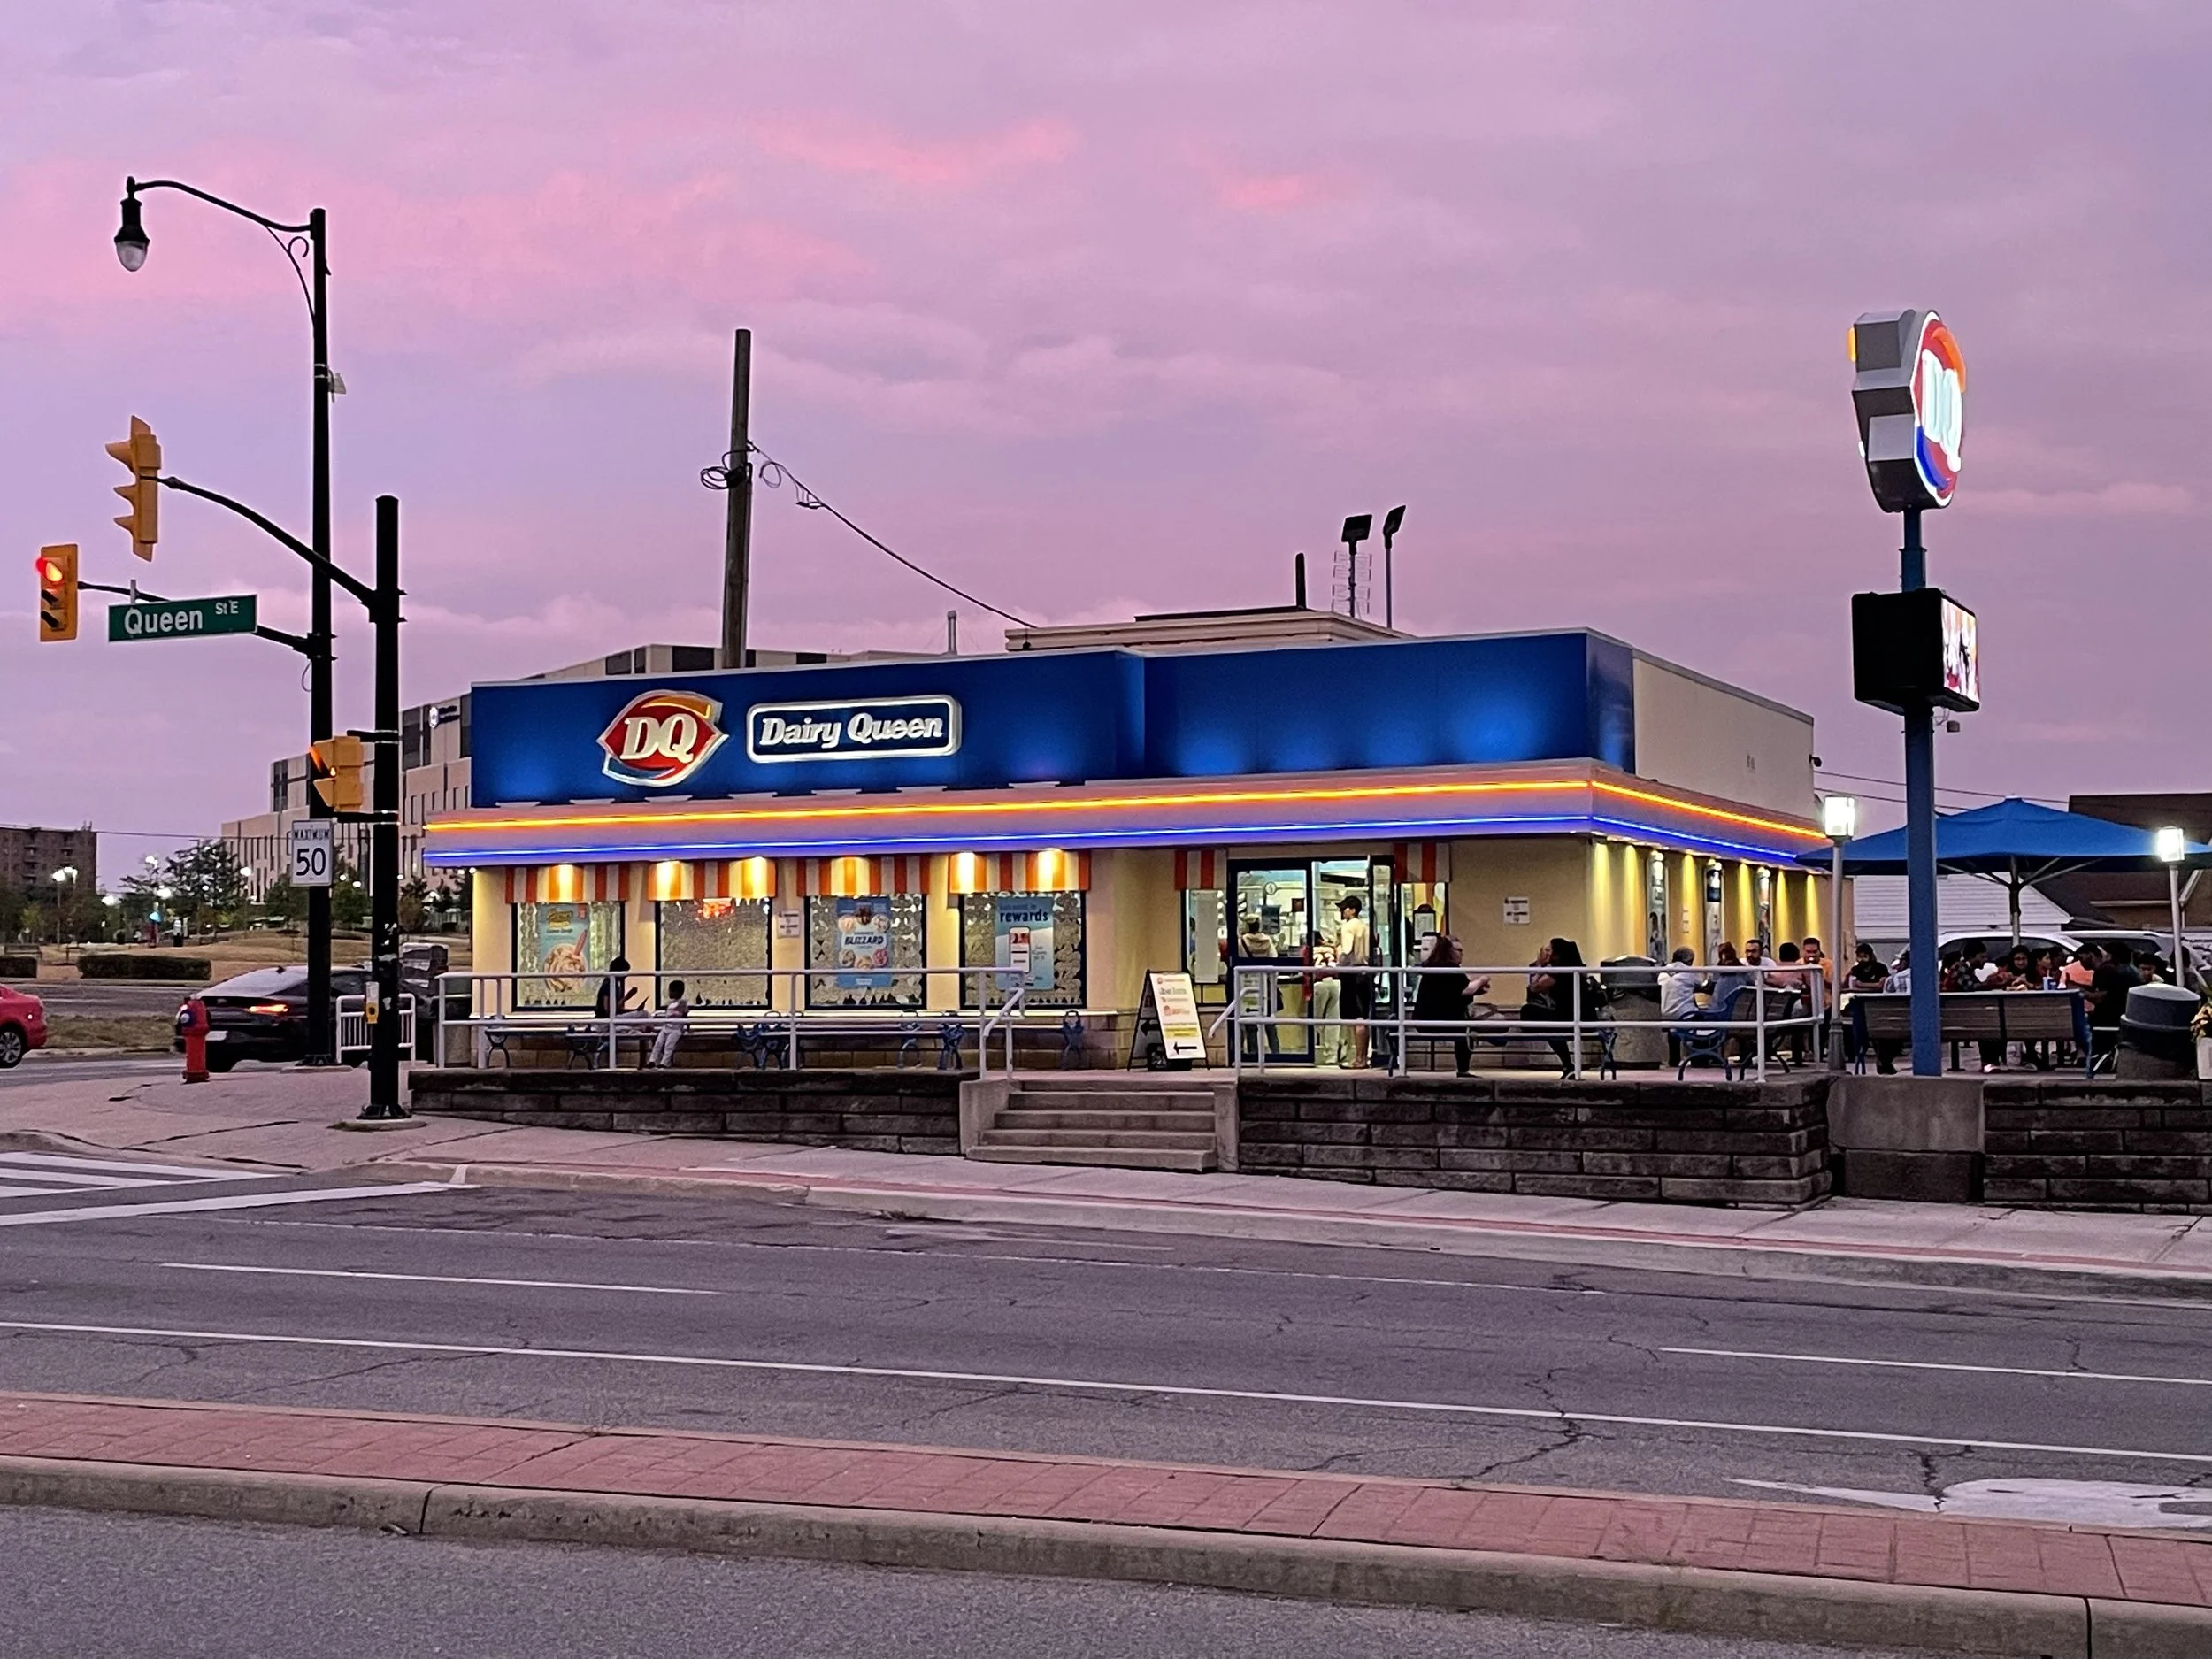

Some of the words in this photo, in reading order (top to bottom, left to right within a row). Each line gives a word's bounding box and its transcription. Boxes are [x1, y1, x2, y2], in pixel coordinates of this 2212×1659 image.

[124, 608, 203, 634] Queen
[215, 602, 227, 615] St
[230, 600, 239, 614] E
[619, 715, 698, 764] DQ
[759, 718, 841, 749] Dairy
[847, 712, 943, 741] Queen
[296, 847, 326, 876] 50
[1000, 909, 1048, 923] rewards
[844, 935, 885, 946] BLIZZARD
